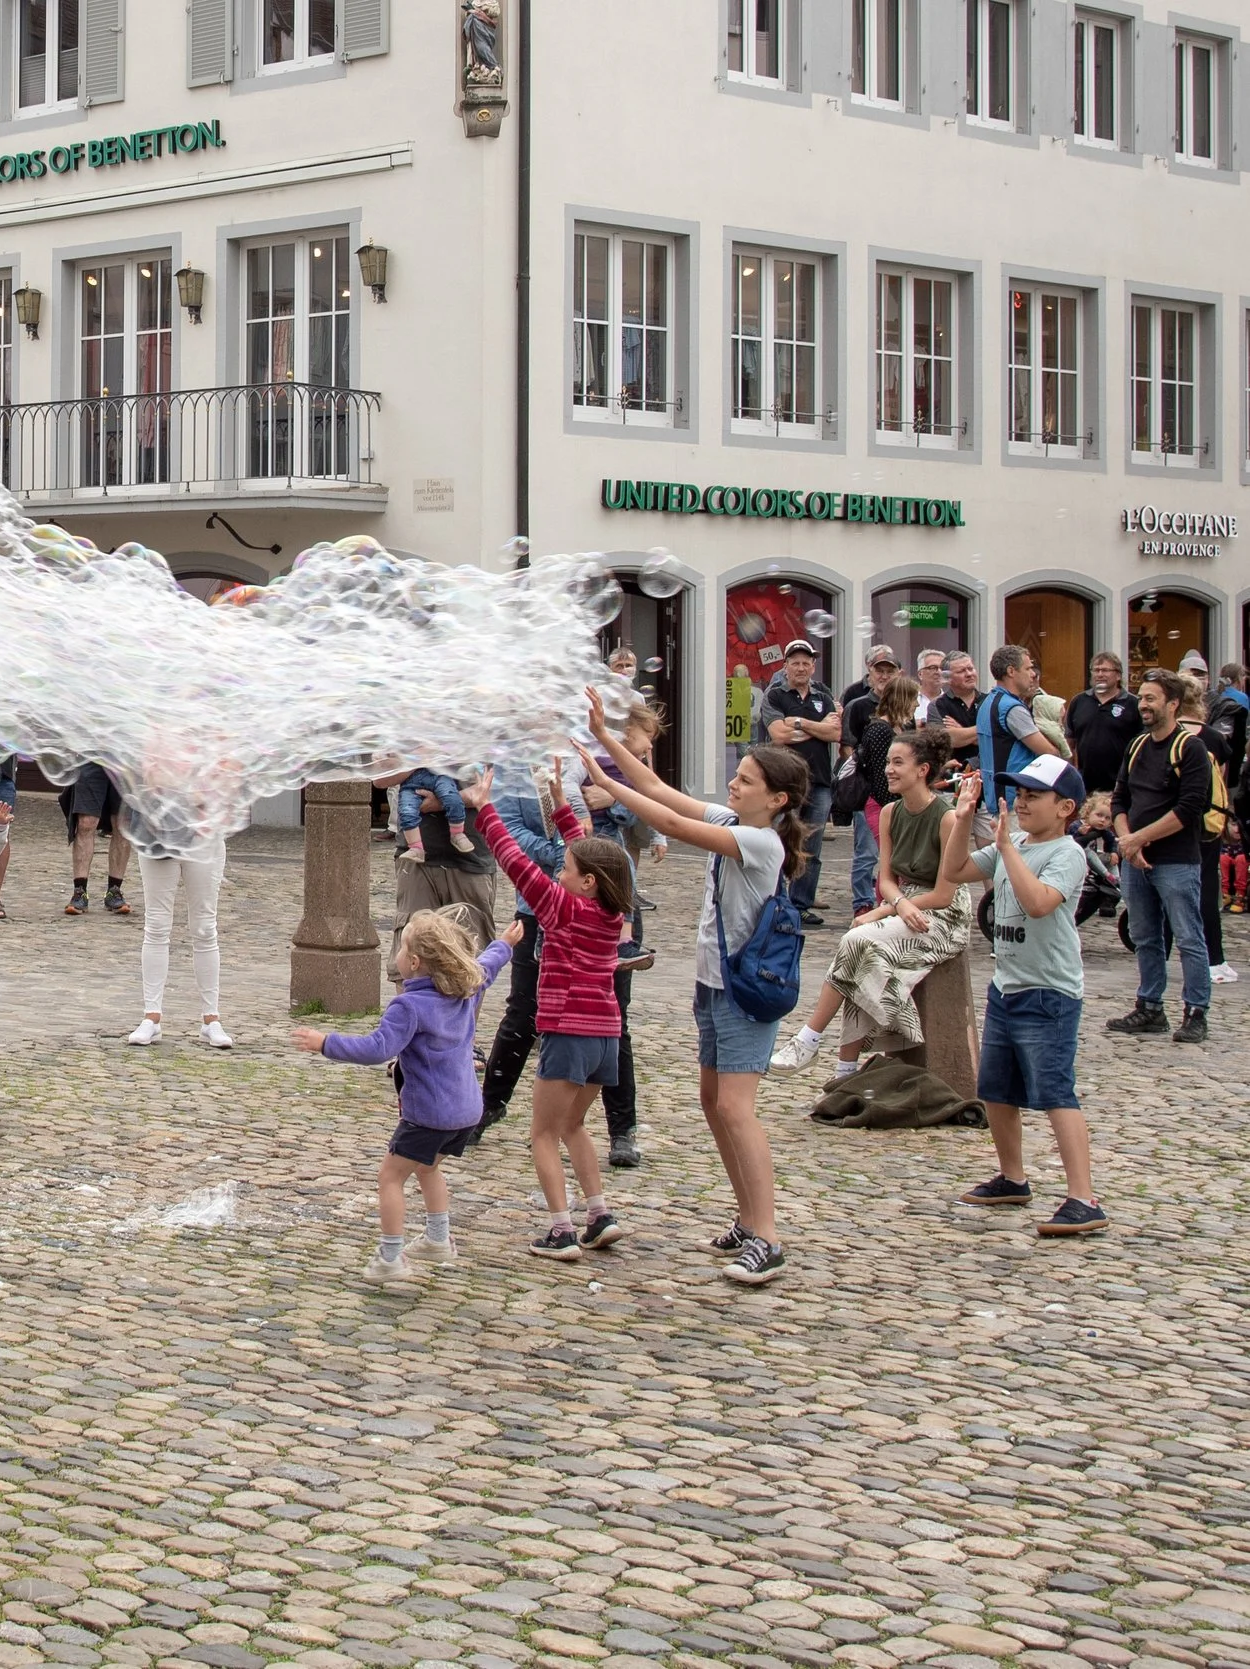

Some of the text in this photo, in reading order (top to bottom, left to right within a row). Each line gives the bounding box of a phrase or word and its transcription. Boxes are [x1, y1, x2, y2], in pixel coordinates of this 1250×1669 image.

[49, 143, 84, 173] OF
[601, 479, 700, 514] UNITED
[703, 485, 806, 519] COLORS
[806, 491, 841, 521] OF
[1143, 541, 1221, 557] EN PROVENCE
